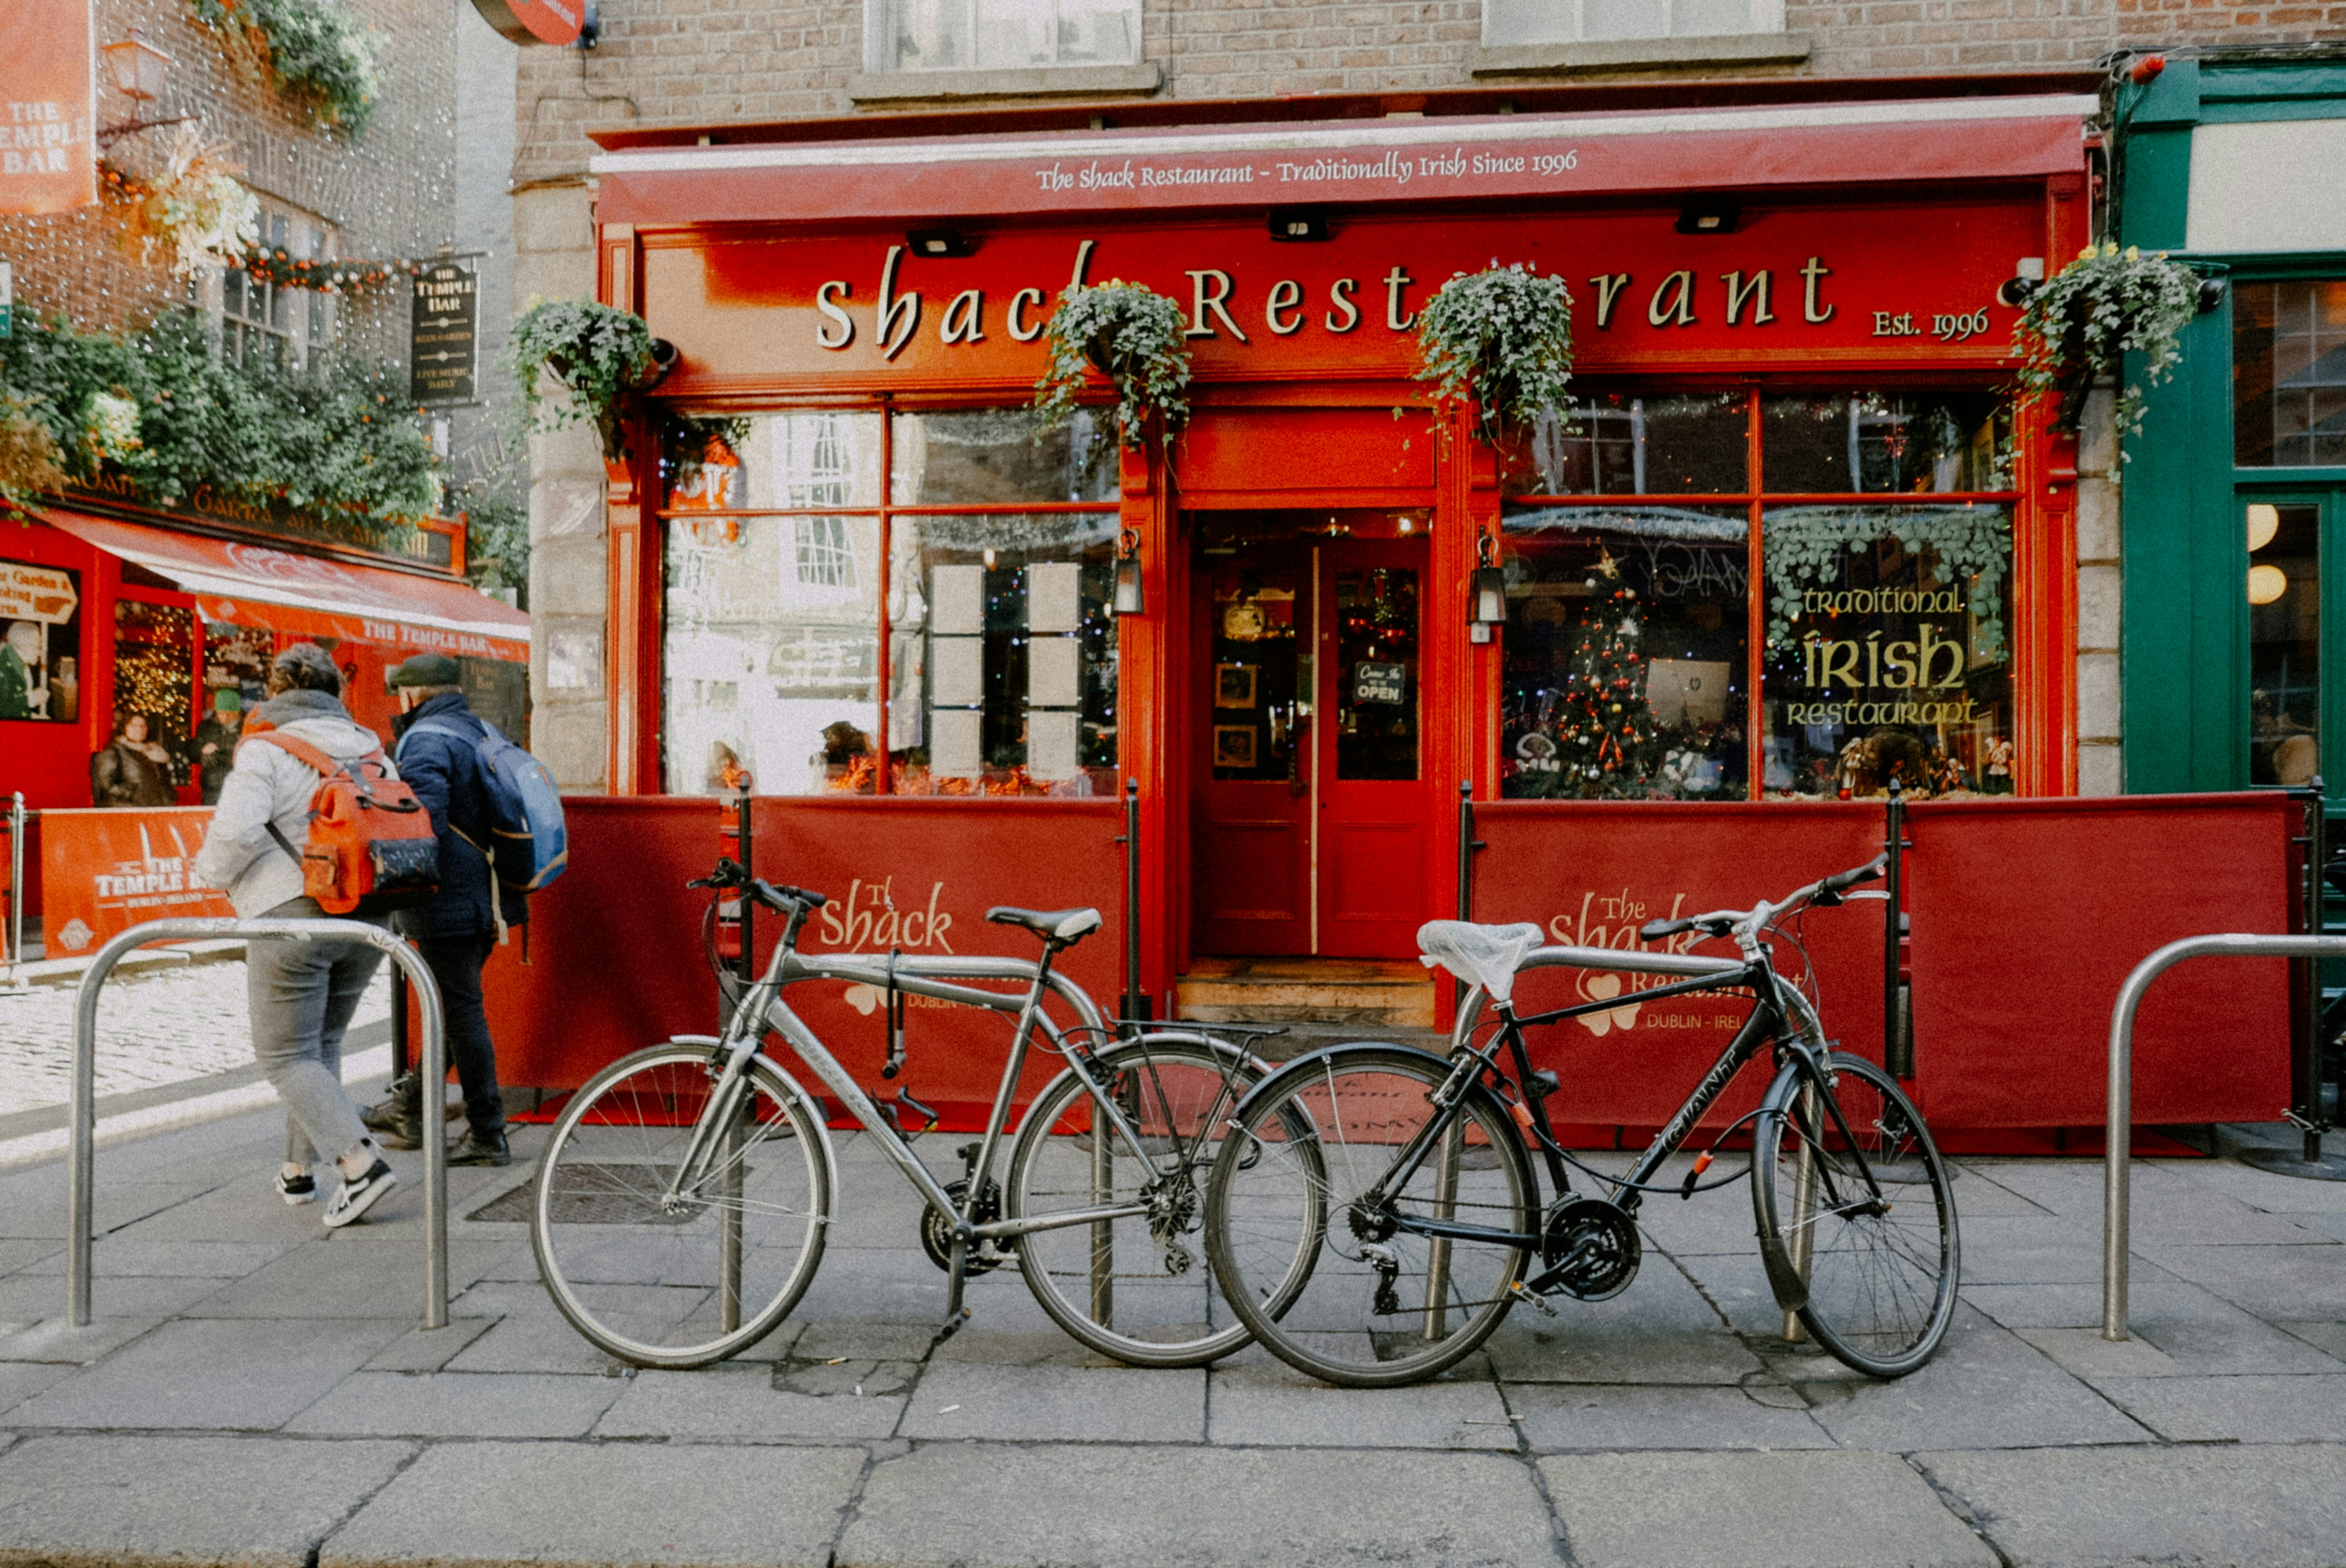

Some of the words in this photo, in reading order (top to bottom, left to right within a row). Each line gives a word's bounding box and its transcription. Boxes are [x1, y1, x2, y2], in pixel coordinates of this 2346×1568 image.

[7, 102, 59, 122] THE
[3, 148, 69, 174] BAR
[1035, 162, 1074, 192] The
[1079, 160, 1135, 191] Shack
[1141, 164, 1254, 187] Restaurant
[1276, 150, 1412, 184] Traditionally
[1420, 148, 1466, 178] Irish
[1473, 152, 1526, 175] Since
[1532, 149, 1578, 176] 1996
[415, 280, 476, 296] TEMPLE
[1183, 256, 1833, 342] Restrant
[428, 298, 461, 312] BAR
[1873, 311, 1922, 337] Est.
[1931, 306, 1989, 341] 1996
[364, 619, 396, 641] THE
[400, 625, 456, 648] TEMPLE
[459, 634, 487, 652] BAR
[1358, 685, 1399, 700] OPEN
[95, 873, 183, 897] TEMPLE
[820, 878, 954, 955] Shack
[1600, 887, 1646, 924] The
[907, 994, 958, 1009] DUBLIN
[1647, 1014, 1702, 1028] DUBLIN
[1714, 1015, 1741, 1029] IREL
